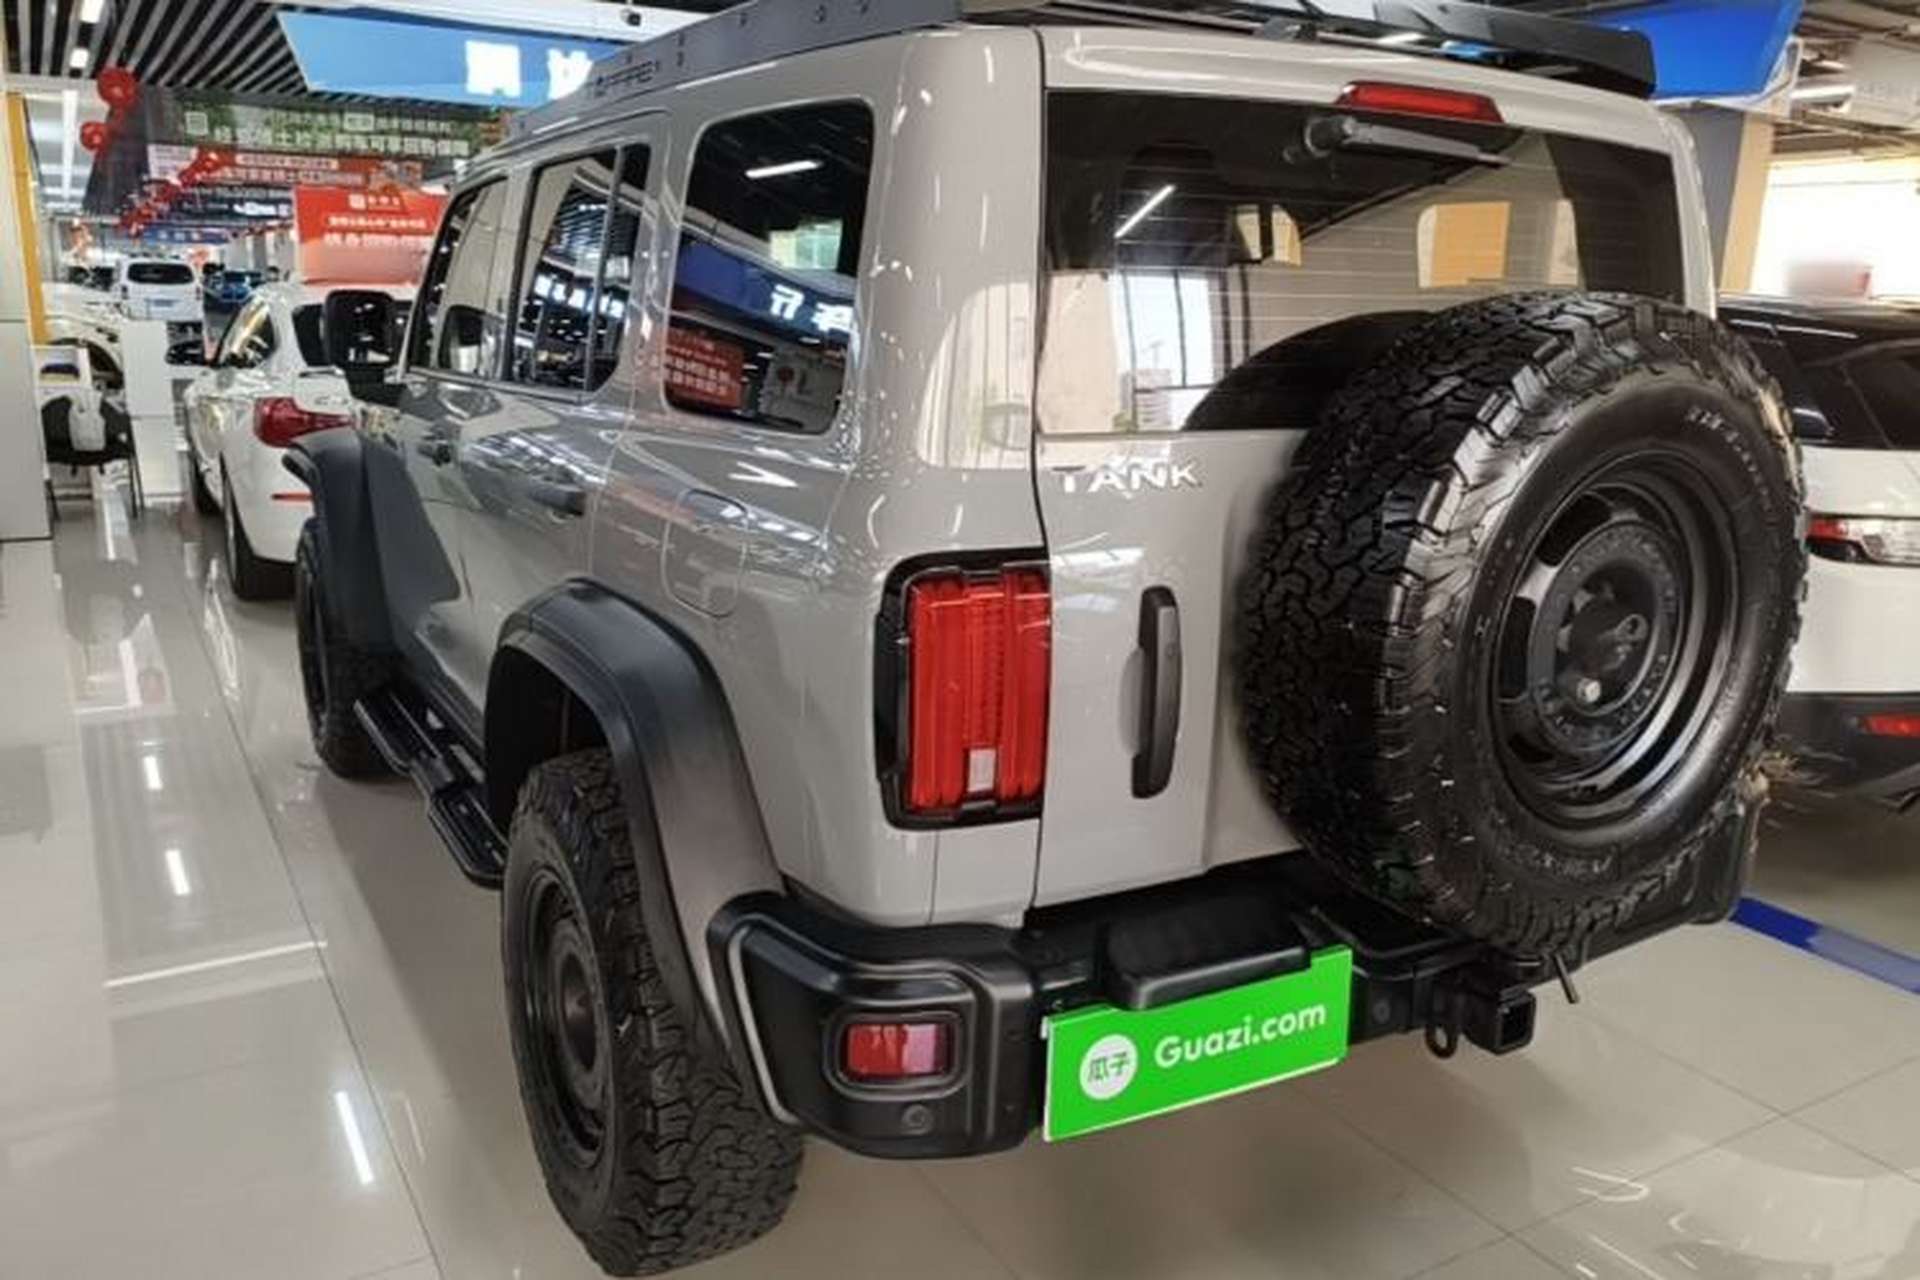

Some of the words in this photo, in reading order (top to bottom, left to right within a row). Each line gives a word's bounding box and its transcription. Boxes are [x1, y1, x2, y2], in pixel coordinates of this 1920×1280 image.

[1052, 462, 1202, 493] TANK
[1154, 1004, 1327, 1068] Guazi.com
[1088, 1051, 1130, 1083] 瓜子
